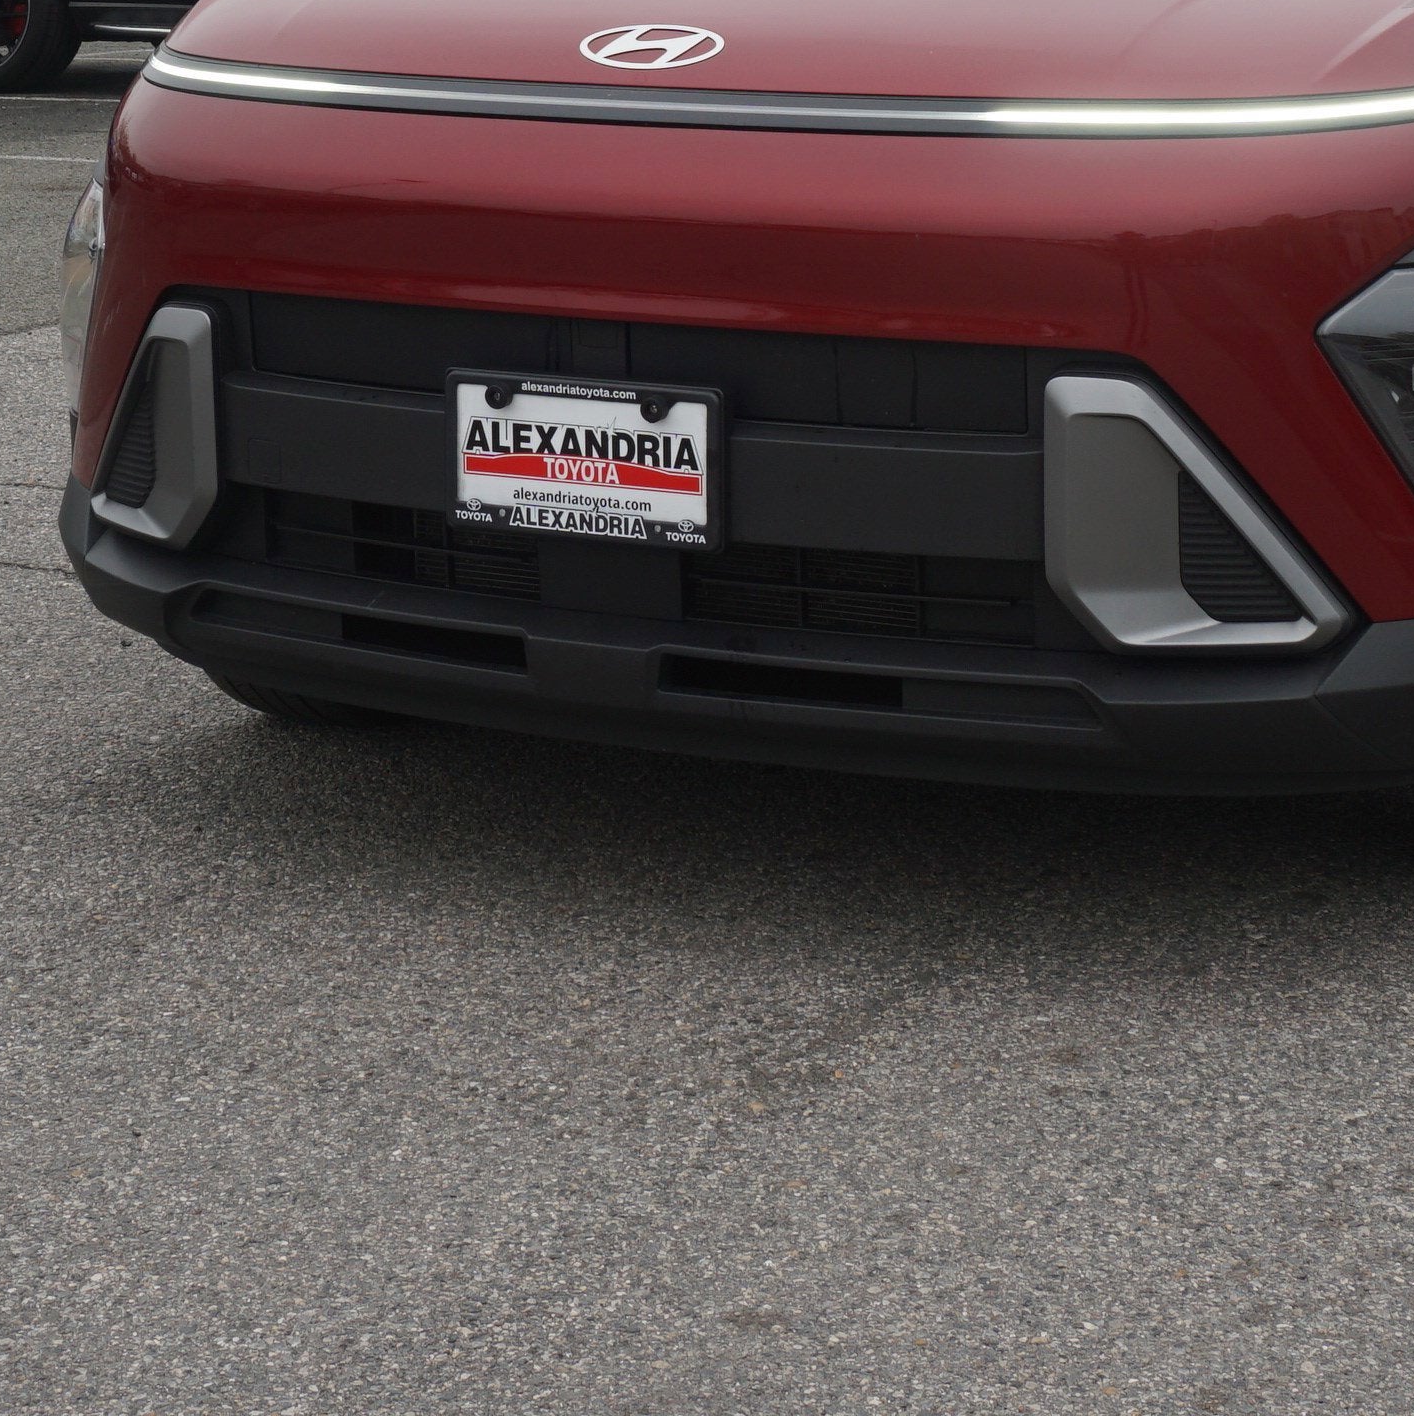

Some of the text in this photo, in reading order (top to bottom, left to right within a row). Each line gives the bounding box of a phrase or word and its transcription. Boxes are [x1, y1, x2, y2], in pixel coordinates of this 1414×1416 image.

[521, 381, 637, 400] alexandriatoyota.com
[465, 417, 701, 473] ALEXANDRIA
[543, 457, 620, 484] TOYOTA
[513, 487, 652, 512] alexandriatoyota.com
[455, 509, 493, 523] TOYOTA
[509, 506, 647, 539] ALEXANDRIA
[665, 531, 706, 544] TOYOTA
